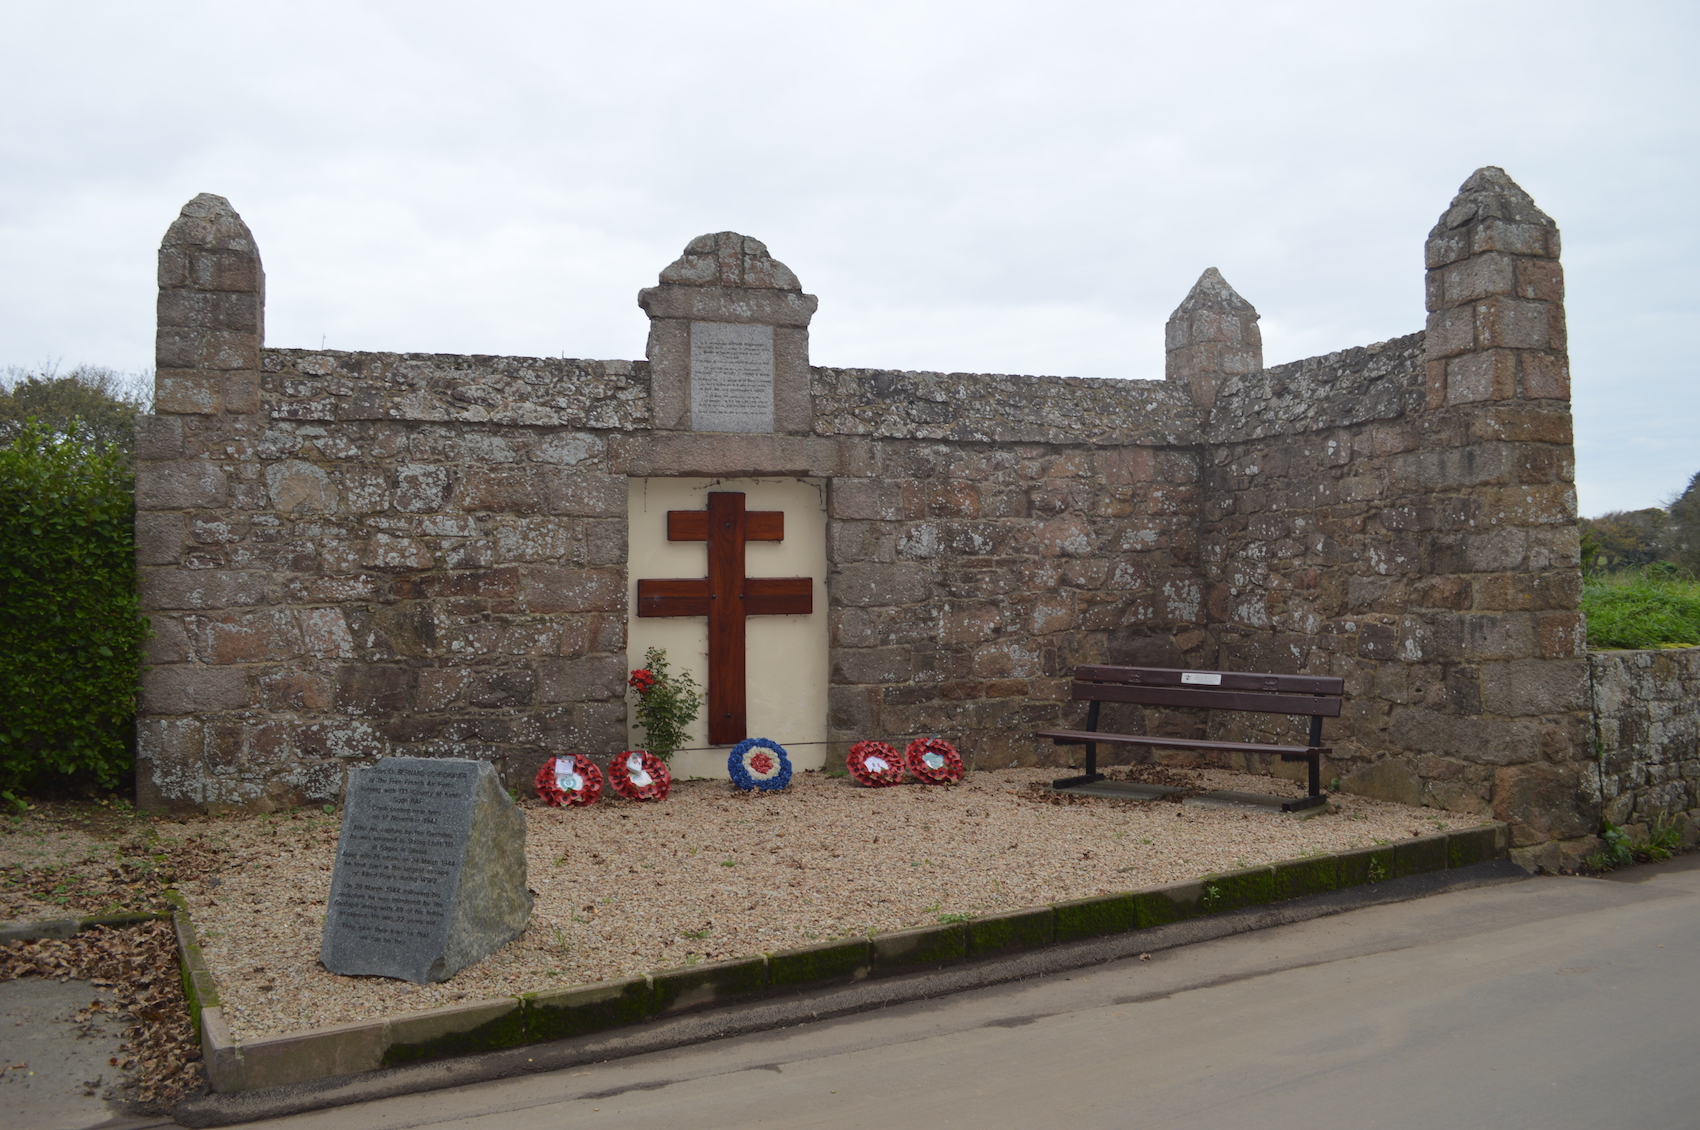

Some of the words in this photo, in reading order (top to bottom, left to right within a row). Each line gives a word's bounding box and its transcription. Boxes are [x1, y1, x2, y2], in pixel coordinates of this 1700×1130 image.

[390, 815, 420, 823] November
[403, 866, 423, 874] largest
[399, 874, 417, 882] during
[364, 884, 382, 892] March
[402, 888, 429, 897] following
[392, 897, 420, 905] murdered
